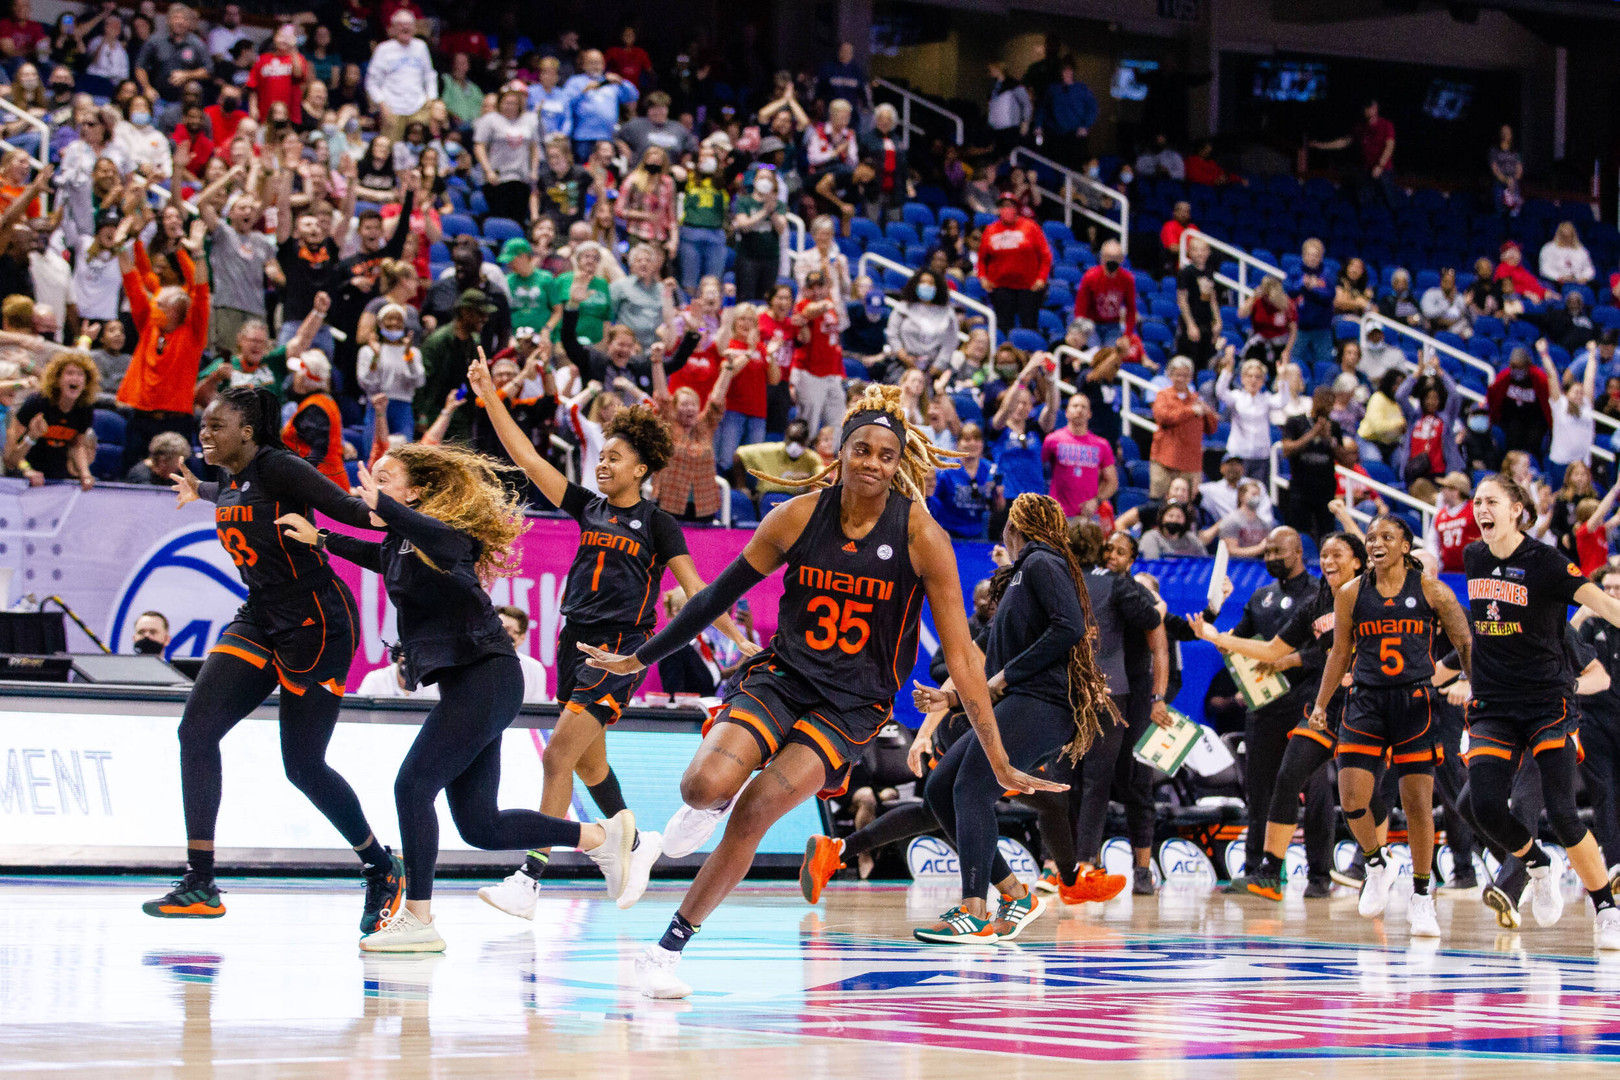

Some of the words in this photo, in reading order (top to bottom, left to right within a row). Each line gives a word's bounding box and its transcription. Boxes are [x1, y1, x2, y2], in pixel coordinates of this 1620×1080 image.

[1056, 443, 1101, 468] DUKE
[591, 551, 606, 592] 1
[1467, 578, 1528, 607] HURRICANES
[805, 595, 874, 655] 35
[1380, 637, 1405, 676] 5
[919, 858, 959, 873] ACC
[1009, 858, 1033, 873] CC
[1171, 860, 1208, 874] ACC
